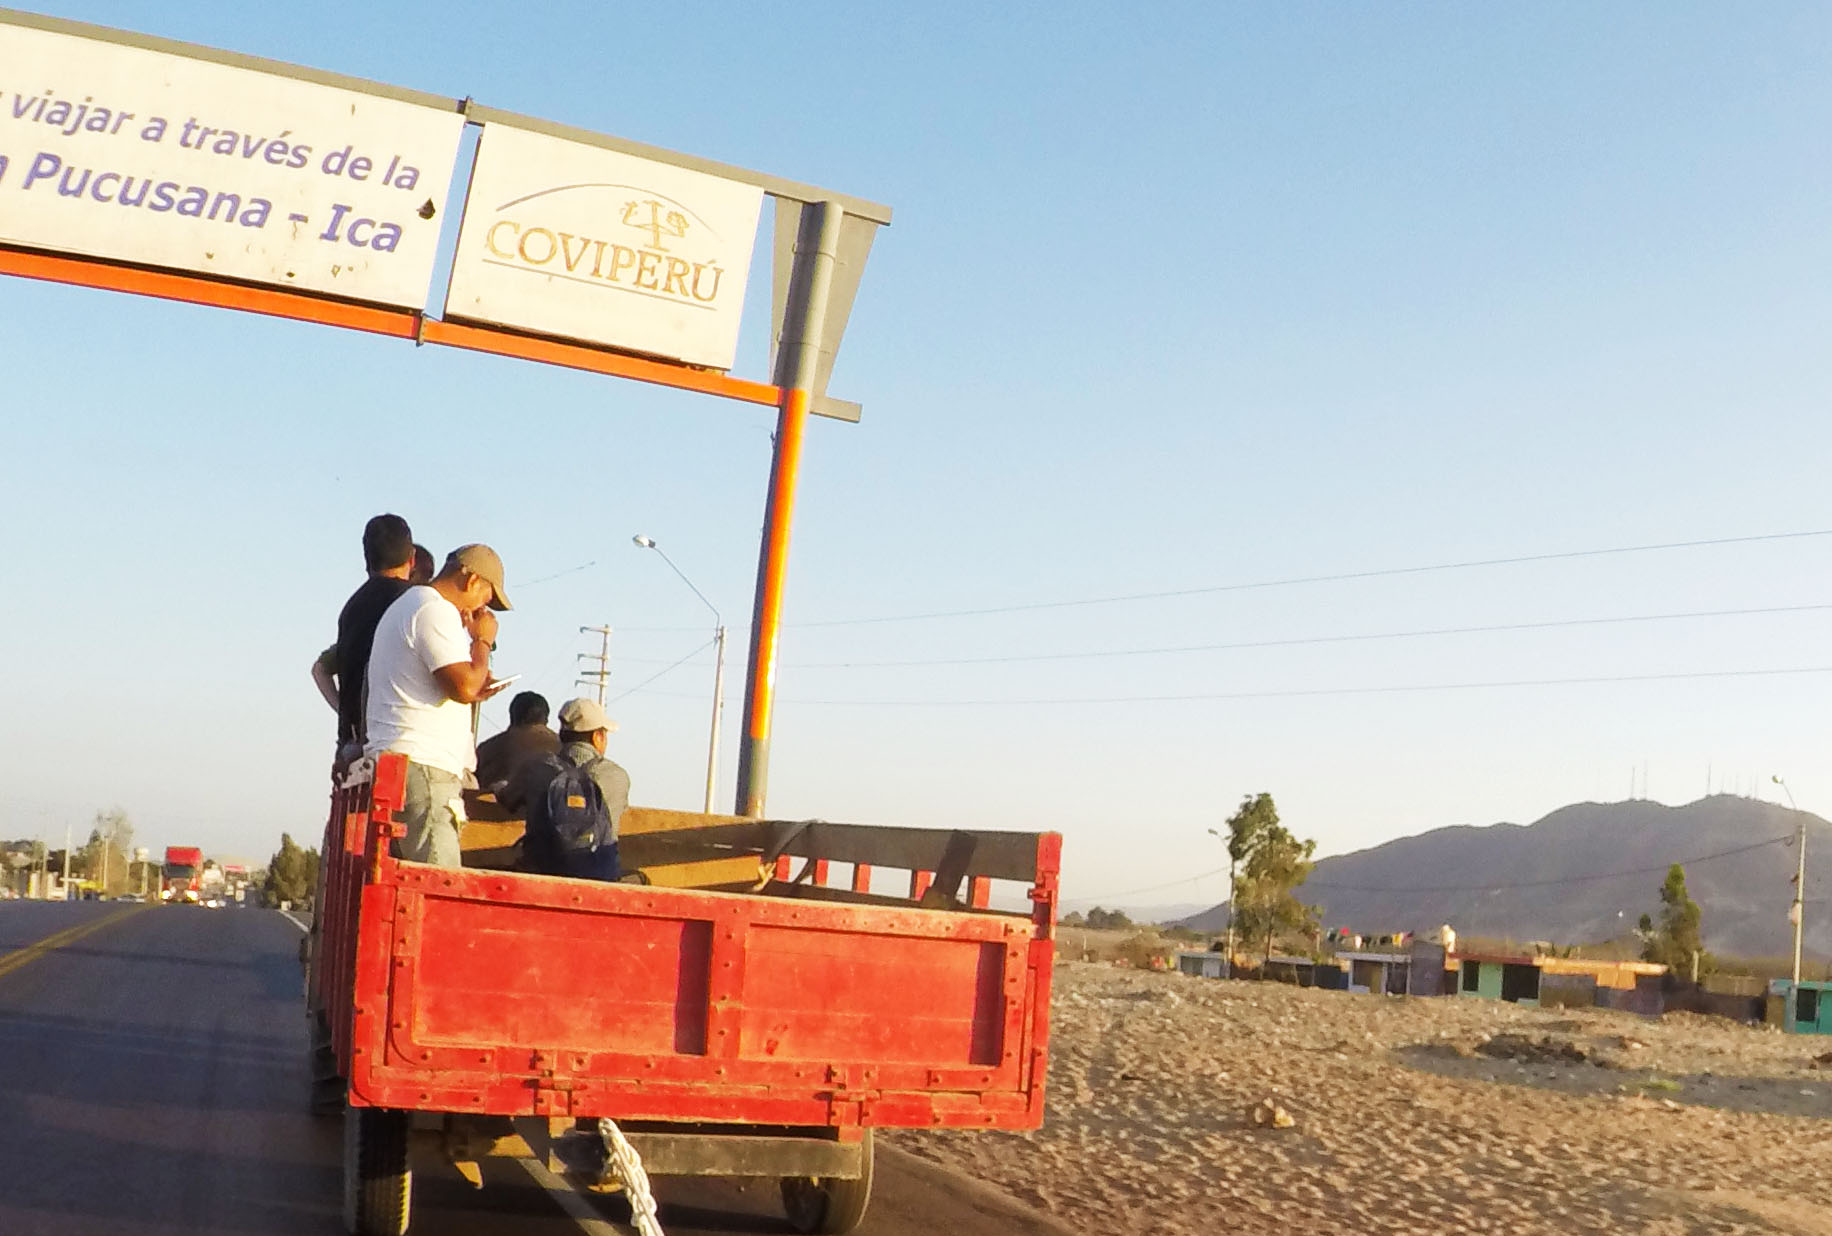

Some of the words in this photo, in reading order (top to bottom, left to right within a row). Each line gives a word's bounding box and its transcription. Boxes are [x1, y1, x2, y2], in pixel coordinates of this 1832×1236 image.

[13, 89, 136, 136] viajar
[140, 116, 168, 142] a
[179, 117, 313, 168] través
[321, 145, 373, 181] de
[382, 155, 420, 190] la
[22, 152, 272, 228] Pucusana
[319, 203, 403, 252] Ica
[485, 220, 725, 302] COVIPERÚ
